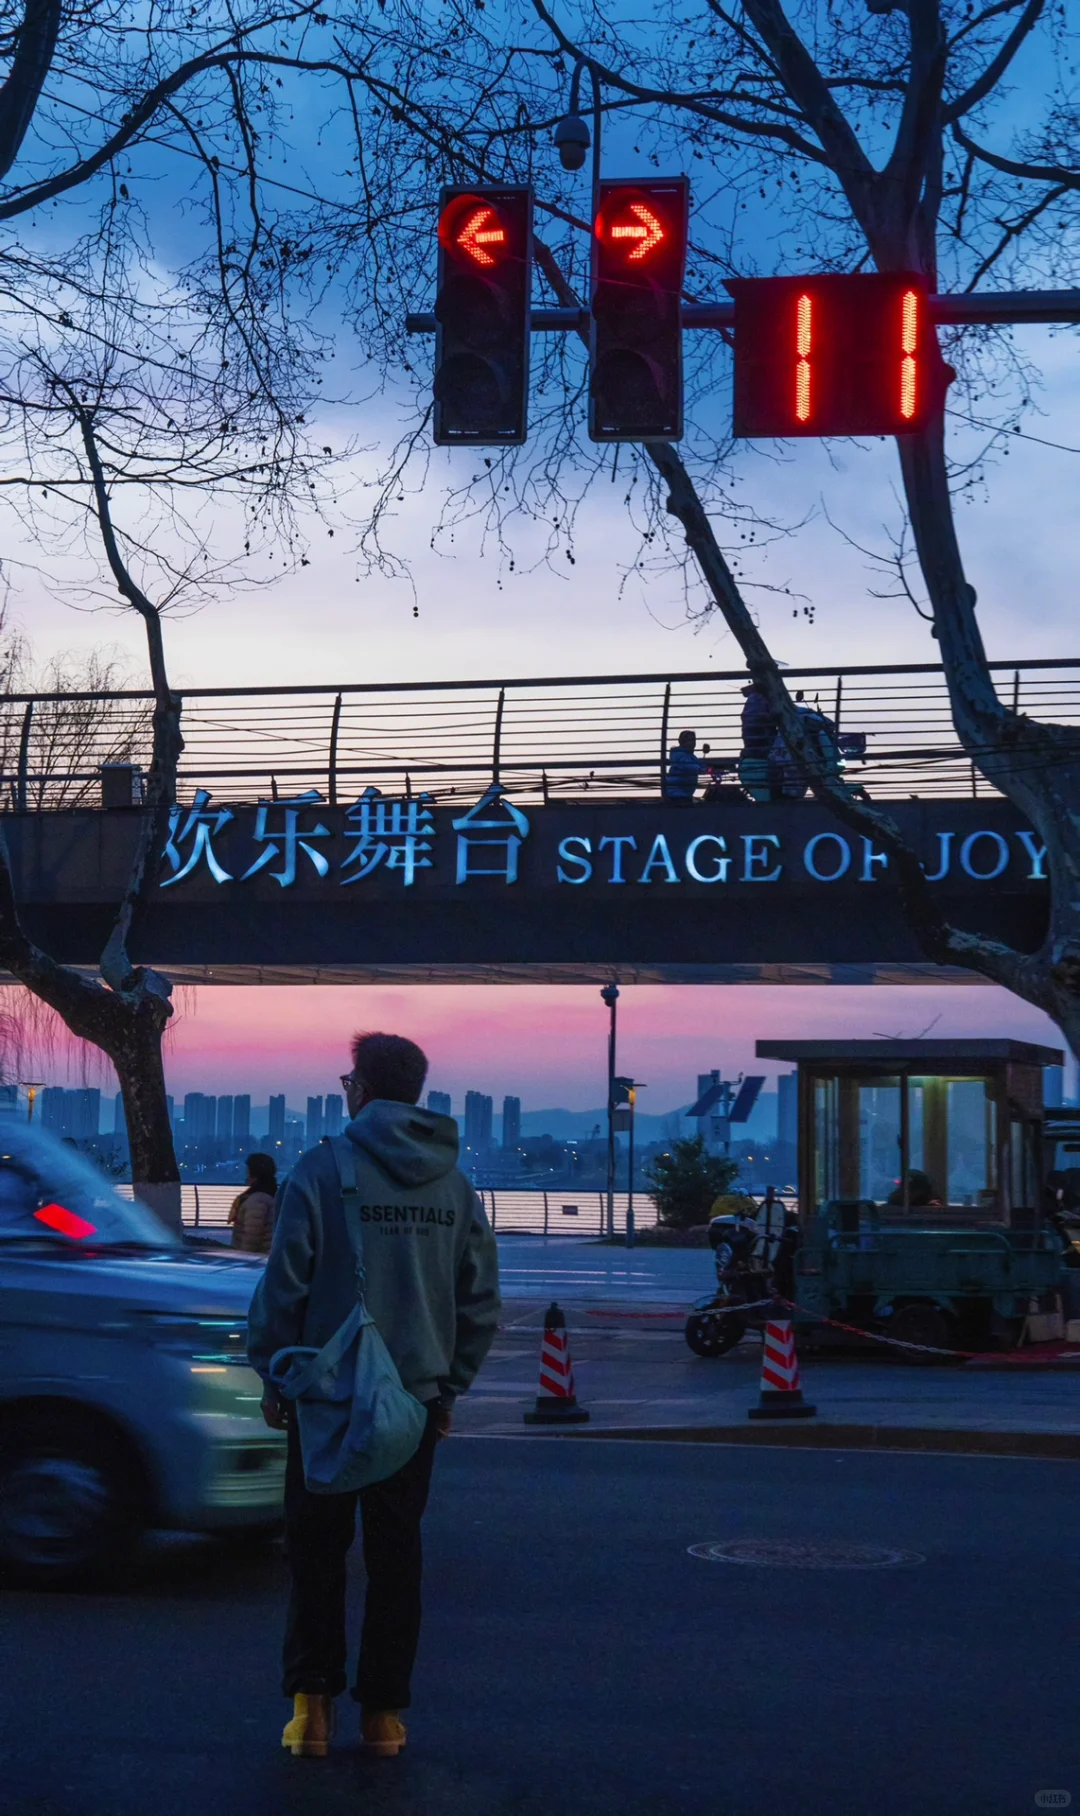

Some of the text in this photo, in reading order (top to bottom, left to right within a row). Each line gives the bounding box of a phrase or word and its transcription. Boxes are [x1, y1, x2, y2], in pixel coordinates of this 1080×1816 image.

[796, 291, 917, 421] 11
[159, 783, 531, 888] 欢乐舞台
[556, 831, 1049, 884] STAGE OF JOY
[360, 1205, 456, 1228] SSENTIALS
